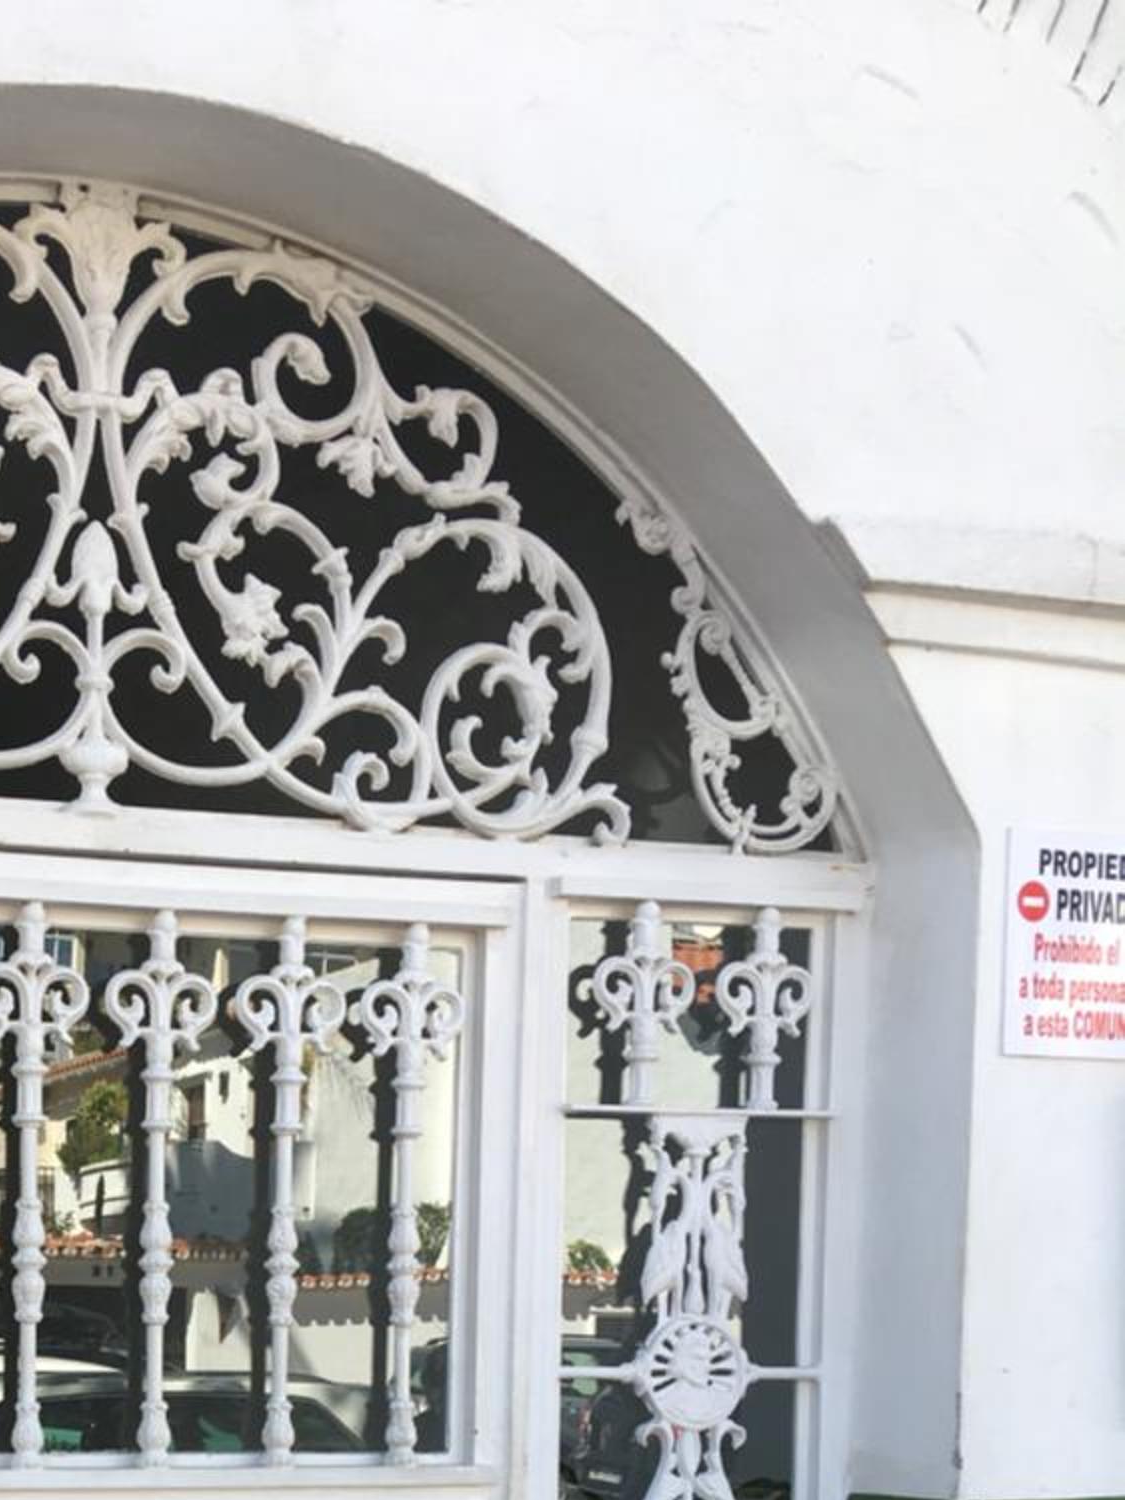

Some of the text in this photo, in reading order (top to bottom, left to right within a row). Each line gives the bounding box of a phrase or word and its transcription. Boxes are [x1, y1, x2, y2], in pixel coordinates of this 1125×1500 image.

[1034, 932, 1102, 965] Prohibido
[1019, 976, 1028, 999] a
[1033, 971, 1065, 1000] toda
[1024, 1013, 1033, 1036] a
[1037, 1011, 1068, 1038] esta
